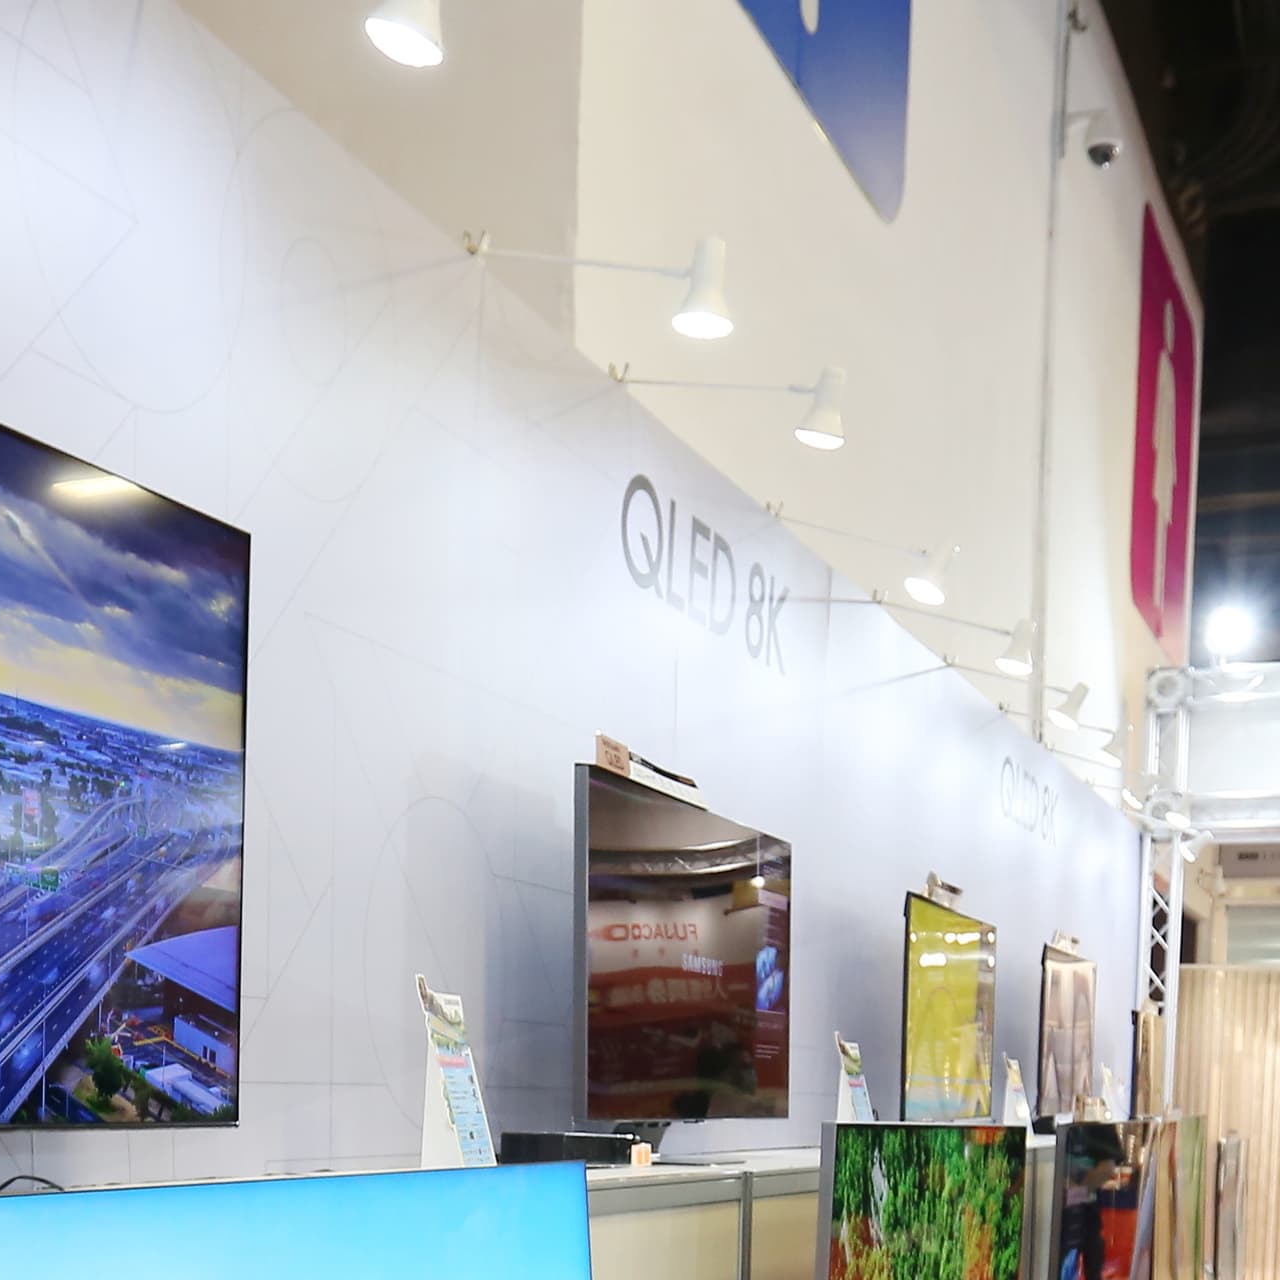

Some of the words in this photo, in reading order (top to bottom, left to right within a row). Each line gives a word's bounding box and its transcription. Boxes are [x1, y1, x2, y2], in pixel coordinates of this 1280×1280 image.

[621, 474, 736, 636] QLED
[744, 562, 790, 675] 8K
[681, 953, 723, 977] SAMSUNG
